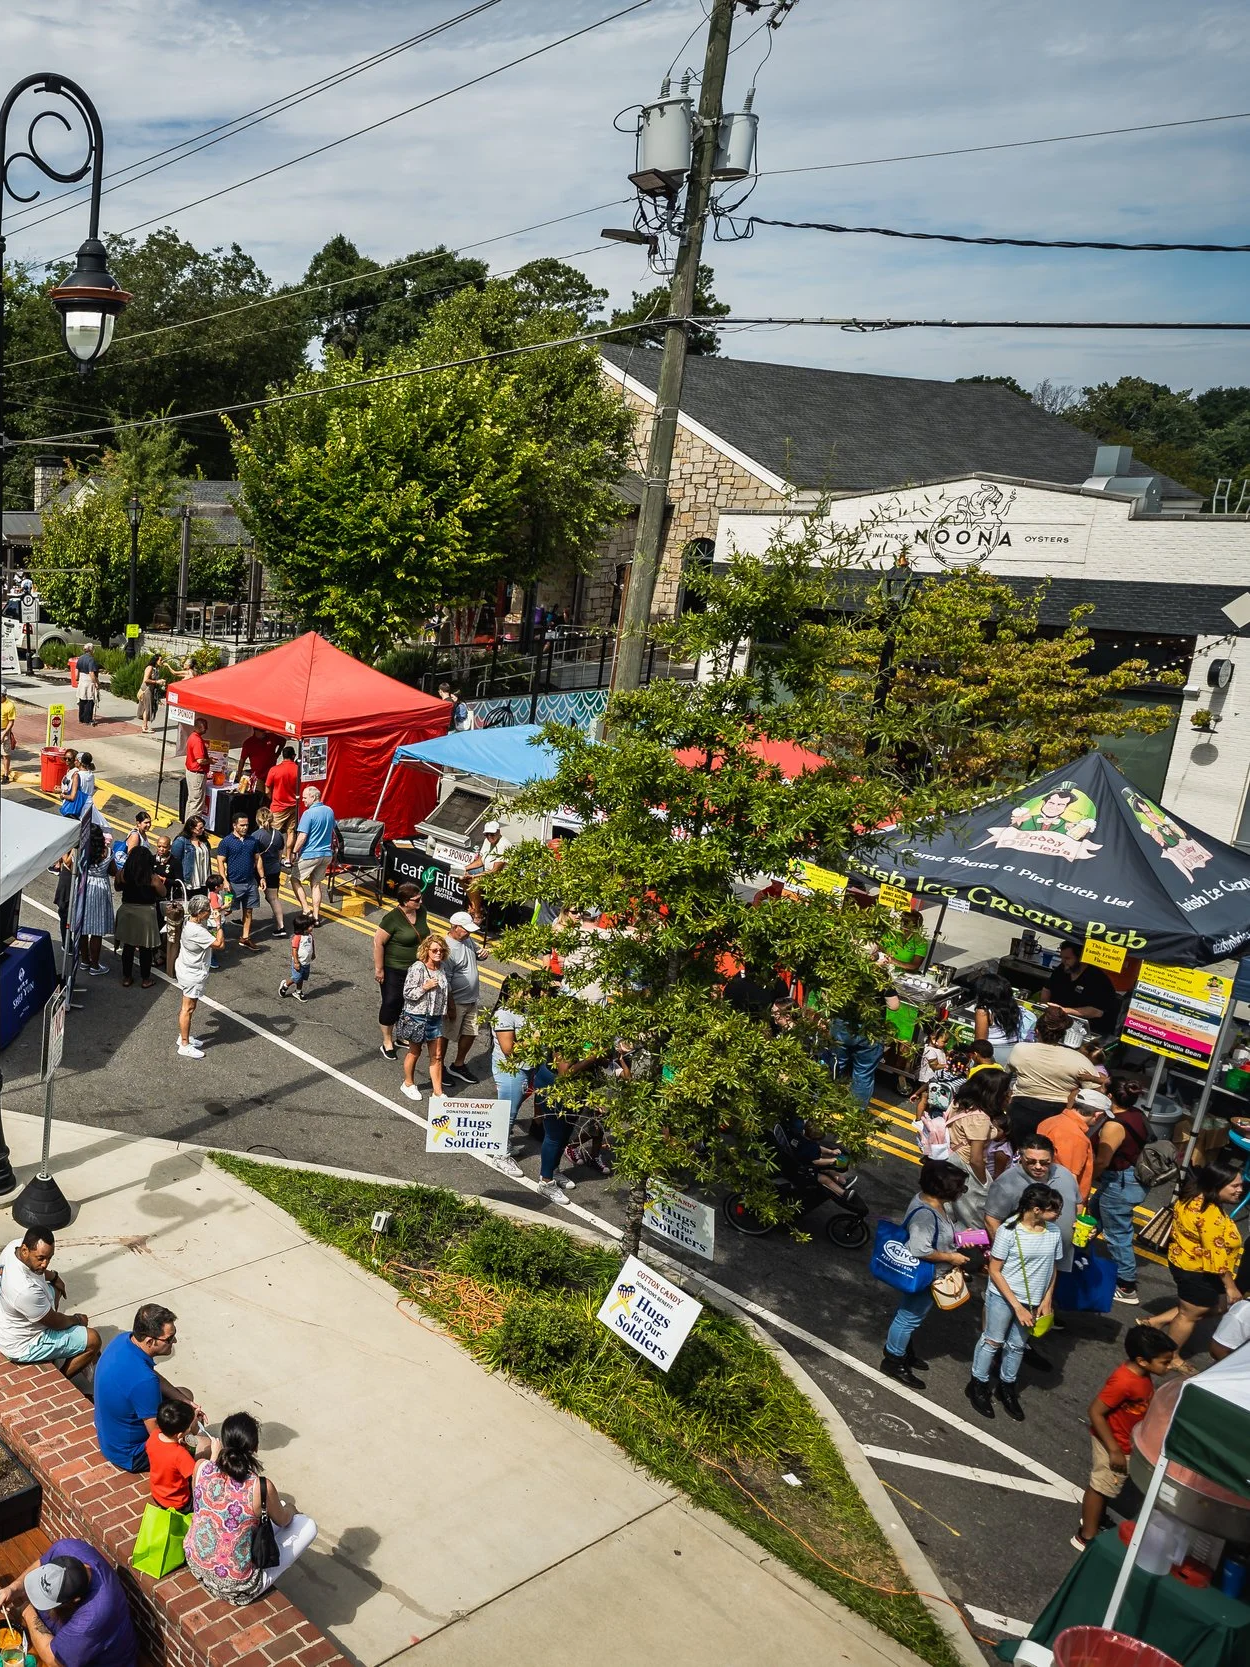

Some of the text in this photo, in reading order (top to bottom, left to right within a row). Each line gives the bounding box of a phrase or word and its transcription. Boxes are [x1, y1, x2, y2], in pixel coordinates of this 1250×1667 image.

[914, 530, 1012, 546] NOONA
[1024, 536, 1069, 544] OYSTERS
[177, 708, 194, 720] SPONSOR
[1014, 832, 1066, 847] Daddy
[449, 846, 473, 863] SPONSOR
[394, 857, 424, 880] Leaf
[435, 871, 467, 896] Filte
[900, 848, 1135, 909] Come Share a Pint with Us!
[434, 887, 453, 896] GUTTER
[434, 891, 463, 905] PROTECTION
[1176, 889, 1210, 913] Irish
[916, 875, 958, 899] Ice
[968, 887, 1073, 933] Cream
[1086, 920, 1148, 950] Pub
[1135, 993, 1159, 1004] Chocolate
[1138, 984, 1161, 995] Family
[1135, 1001, 1158, 1015] Toasted
[1128, 1019, 1148, 1031] Cotton
[1148, 1025, 1167, 1038] Candy
[1127, 1028, 1163, 1045] Madagascar
[1163, 1039, 1184, 1052] Vanilla
[1184, 1047, 1202, 1059] Bean
[456, 1117, 492, 1131] Hugs
[445, 1137, 500, 1150] Soldiers
[673, 1196, 698, 1211] CANDY
[661, 1202, 697, 1228] Hugs
[650, 1215, 708, 1253] Soldiers
[662, 1215, 695, 1236] for Our
[636, 1280, 675, 1312] DONATIONS BENEFIT:
[637, 1270, 684, 1306] COTTON CANDY
[636, 1295, 671, 1330] Hugs
[631, 1312, 662, 1338] for Our
[615, 1313, 668, 1362] Soldiers
